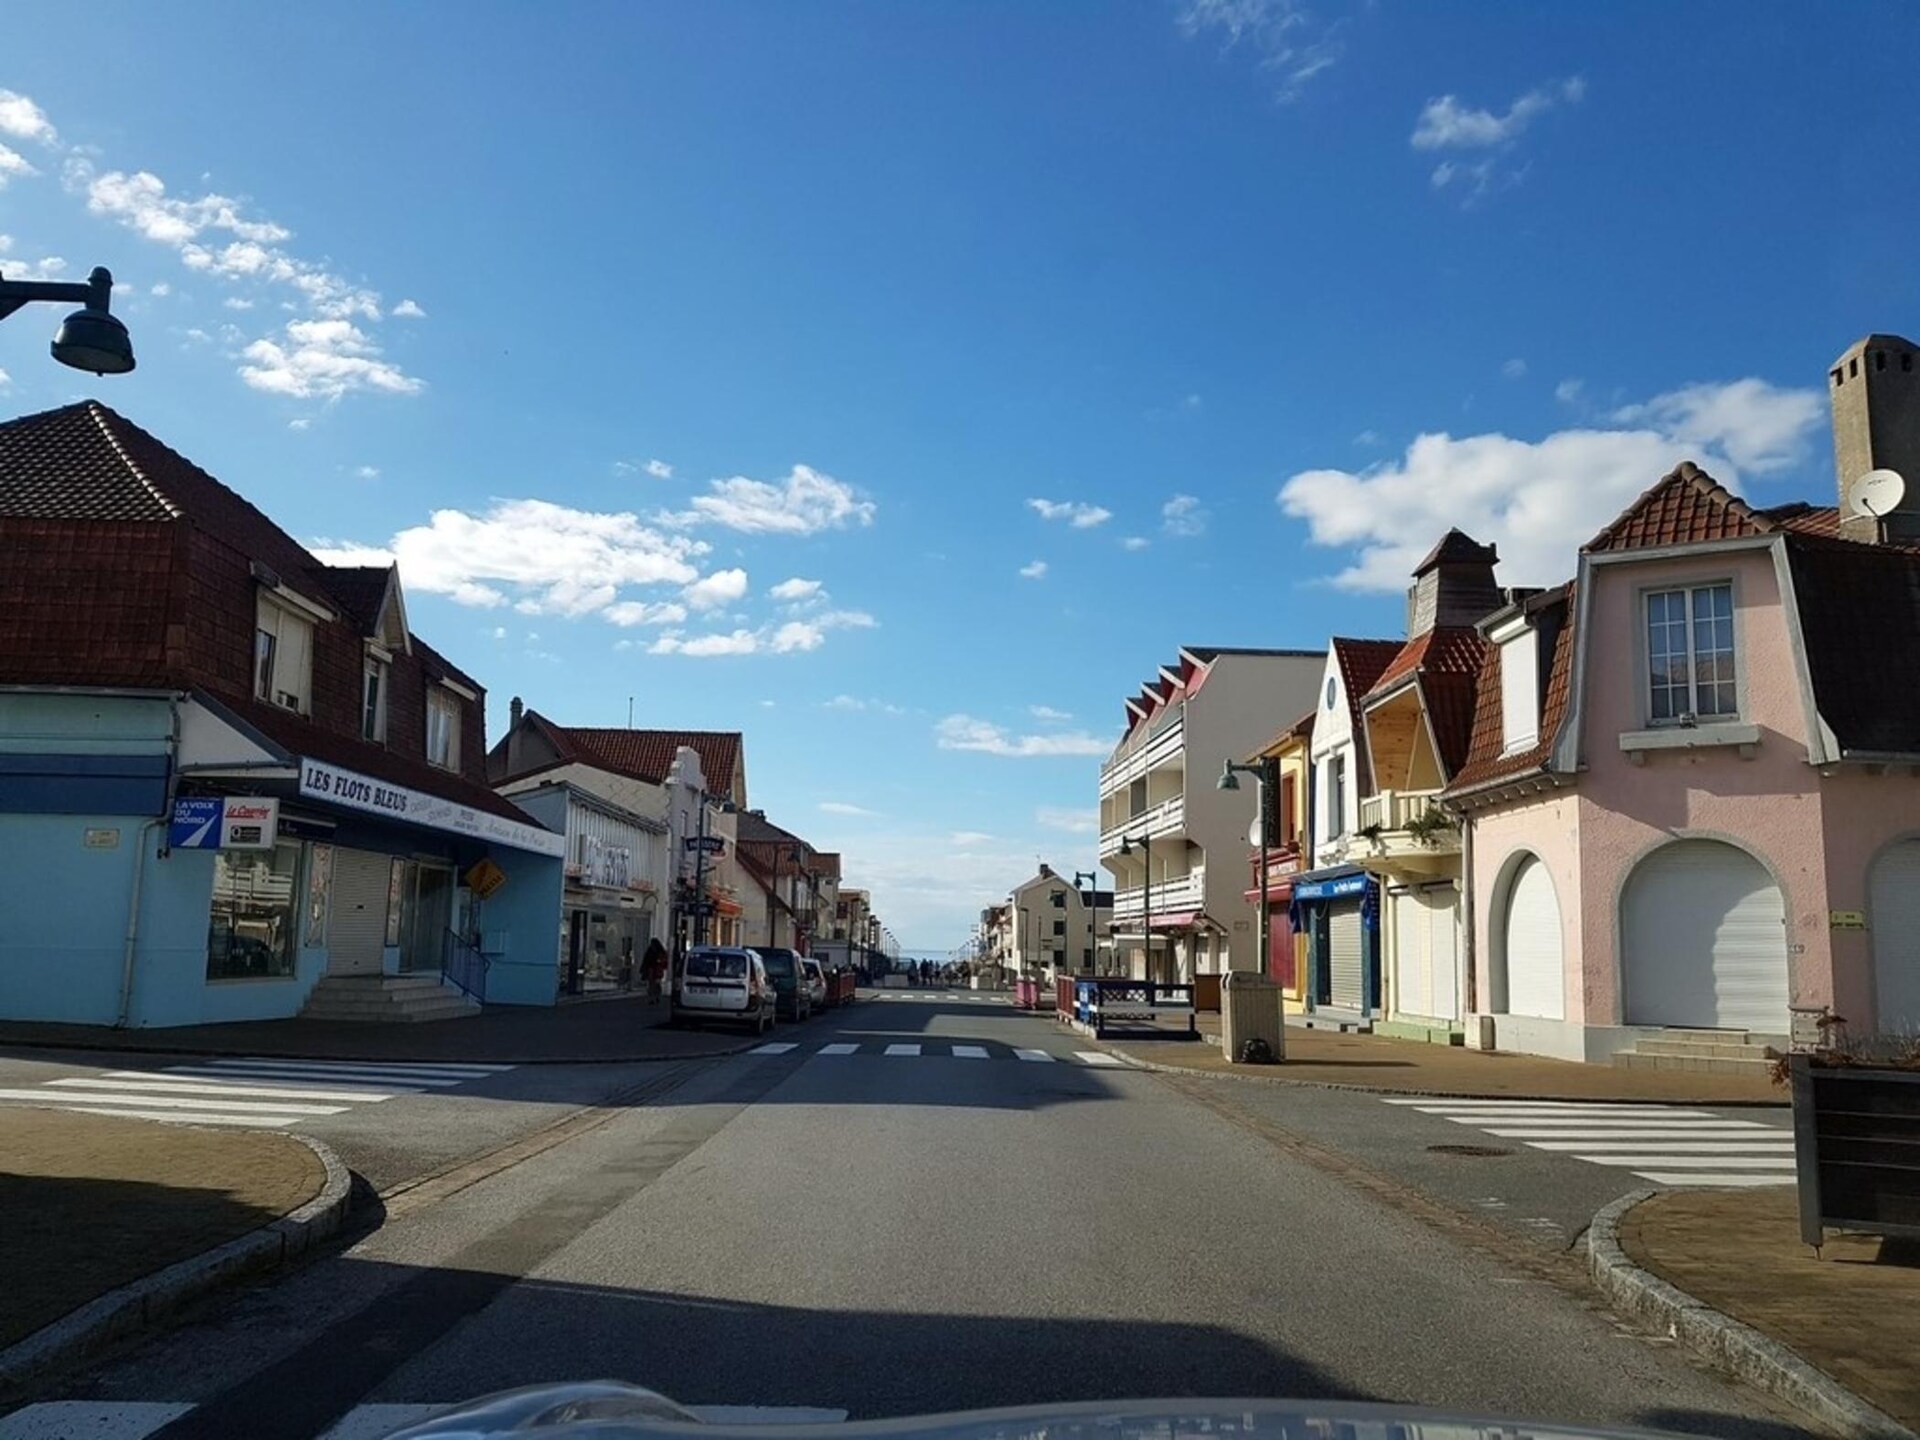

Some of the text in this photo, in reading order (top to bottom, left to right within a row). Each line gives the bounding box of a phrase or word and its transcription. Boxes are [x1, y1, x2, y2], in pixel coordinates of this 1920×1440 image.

[305, 768, 331, 792] LES
[333, 776, 371, 803] FLOTS
[373, 787, 407, 812] BLEUS
[189, 802, 214, 810] VOIX
